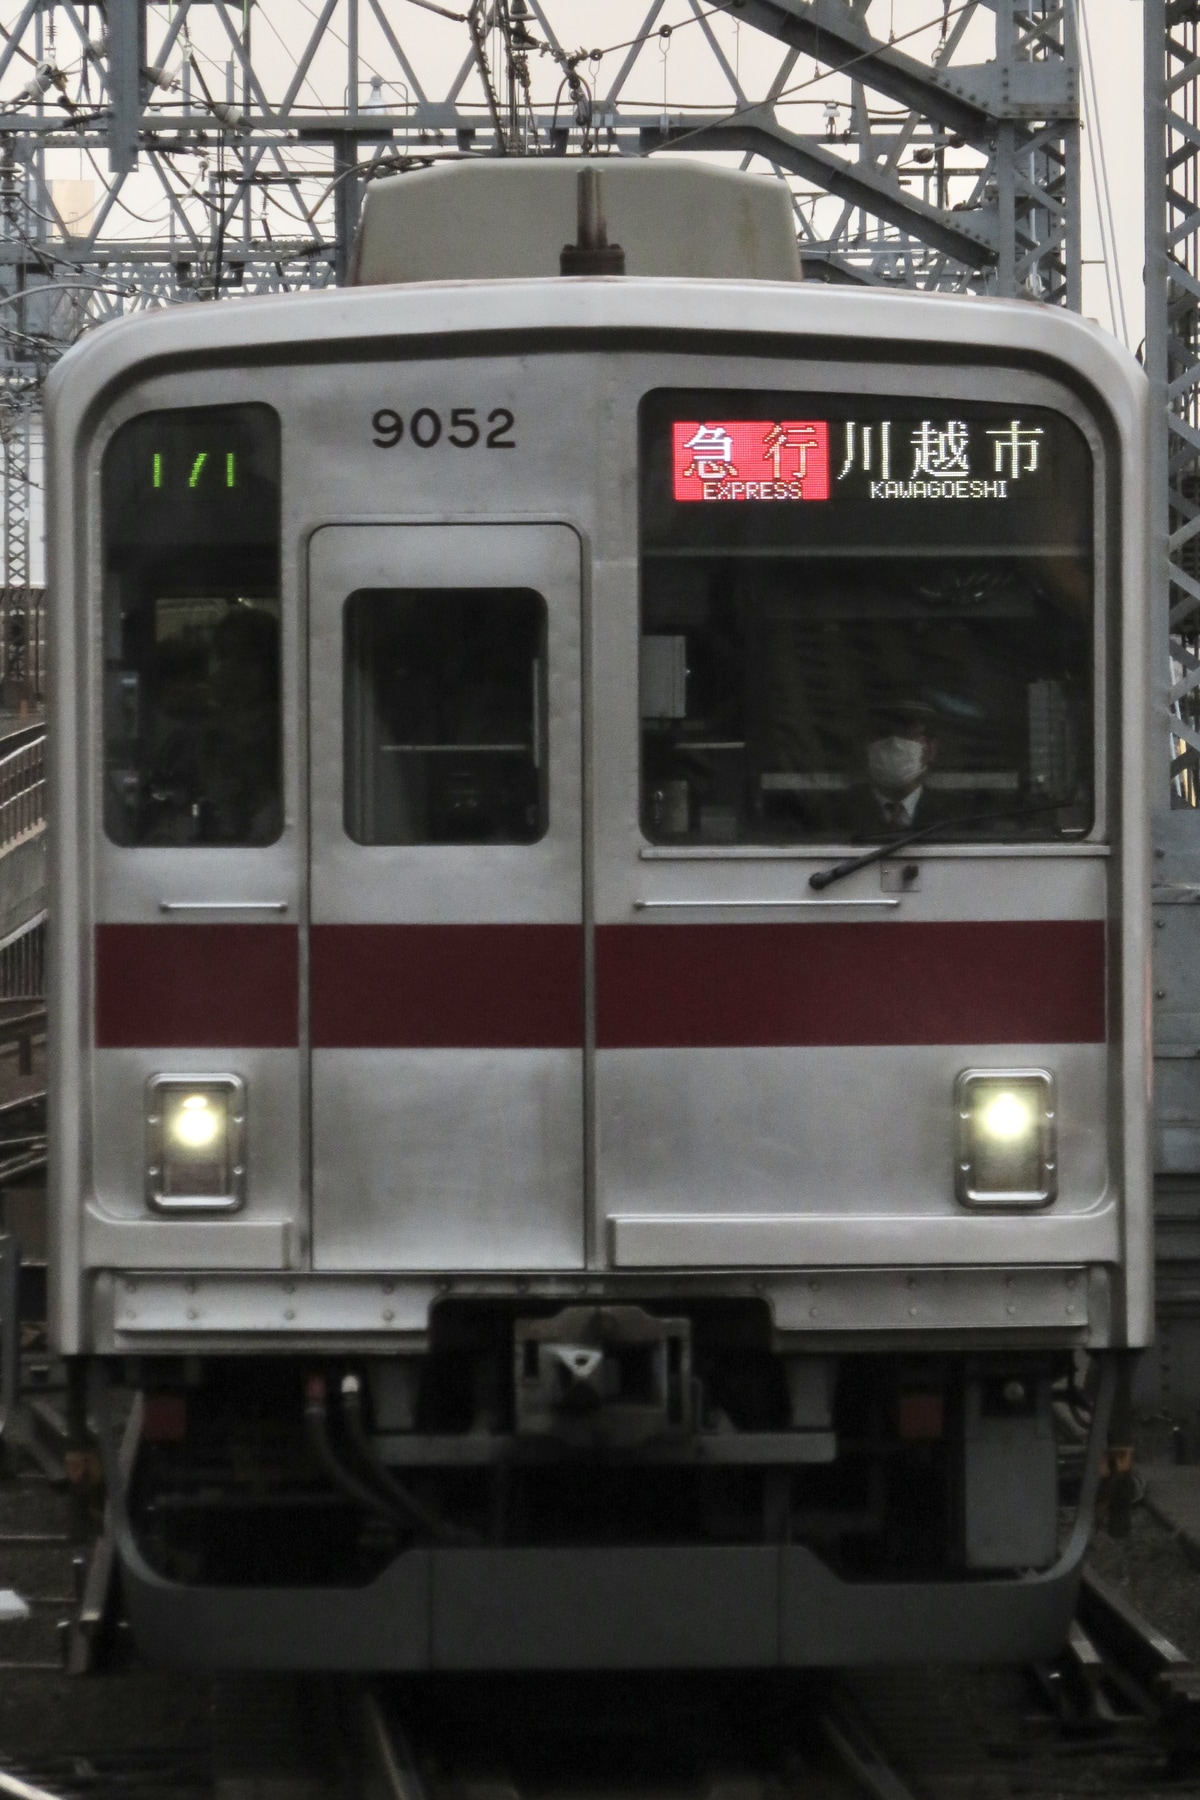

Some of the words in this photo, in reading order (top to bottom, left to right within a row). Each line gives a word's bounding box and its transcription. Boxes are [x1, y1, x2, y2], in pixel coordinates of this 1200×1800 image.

[371, 407, 516, 449] 9052
[683, 423, 819, 479] 急行
[836, 421, 1044, 480] 川越市
[702, 481, 802, 500] EXPRESS
[869, 480, 1008, 499] KAWAGOESHI
